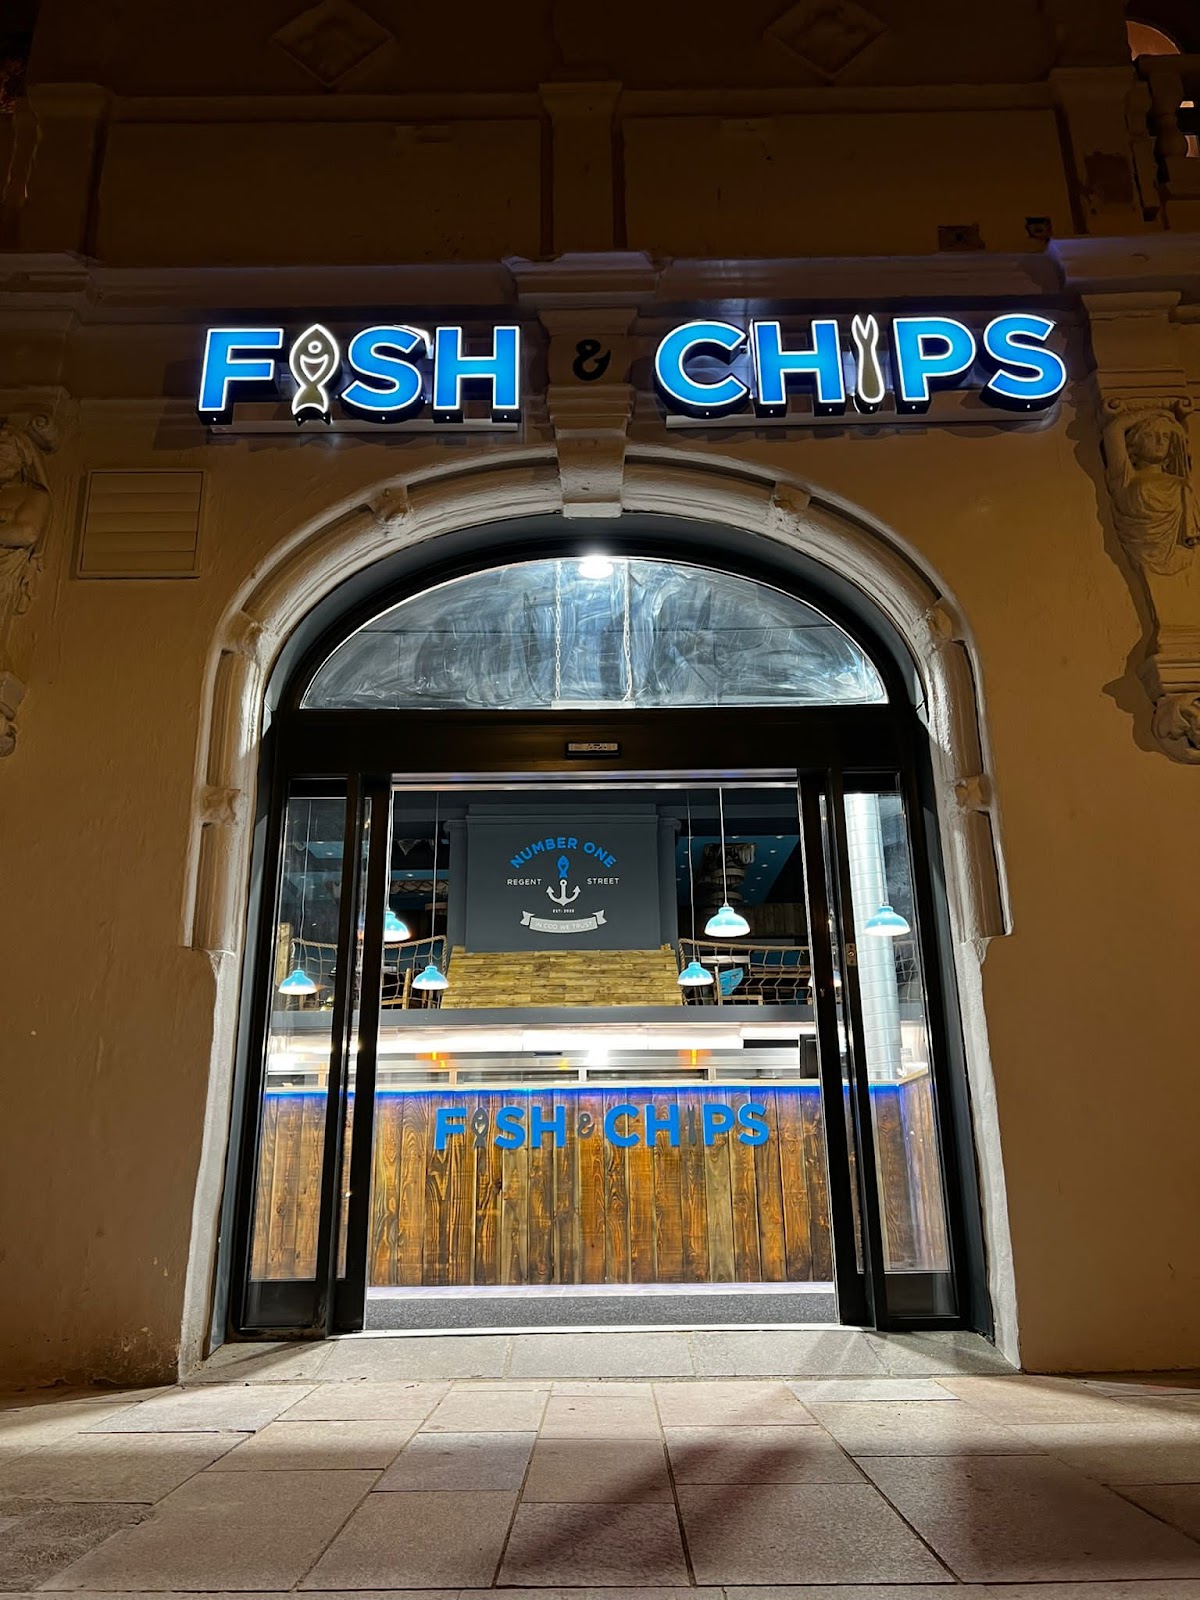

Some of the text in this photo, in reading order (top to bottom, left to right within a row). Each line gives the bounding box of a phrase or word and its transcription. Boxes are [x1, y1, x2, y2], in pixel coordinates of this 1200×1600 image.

[573, 339, 612, 381] &
[510, 837, 617, 869] NUMBER ONE
[506, 877, 620, 886] REGENT STREET
[577, 1112, 595, 1139] &
